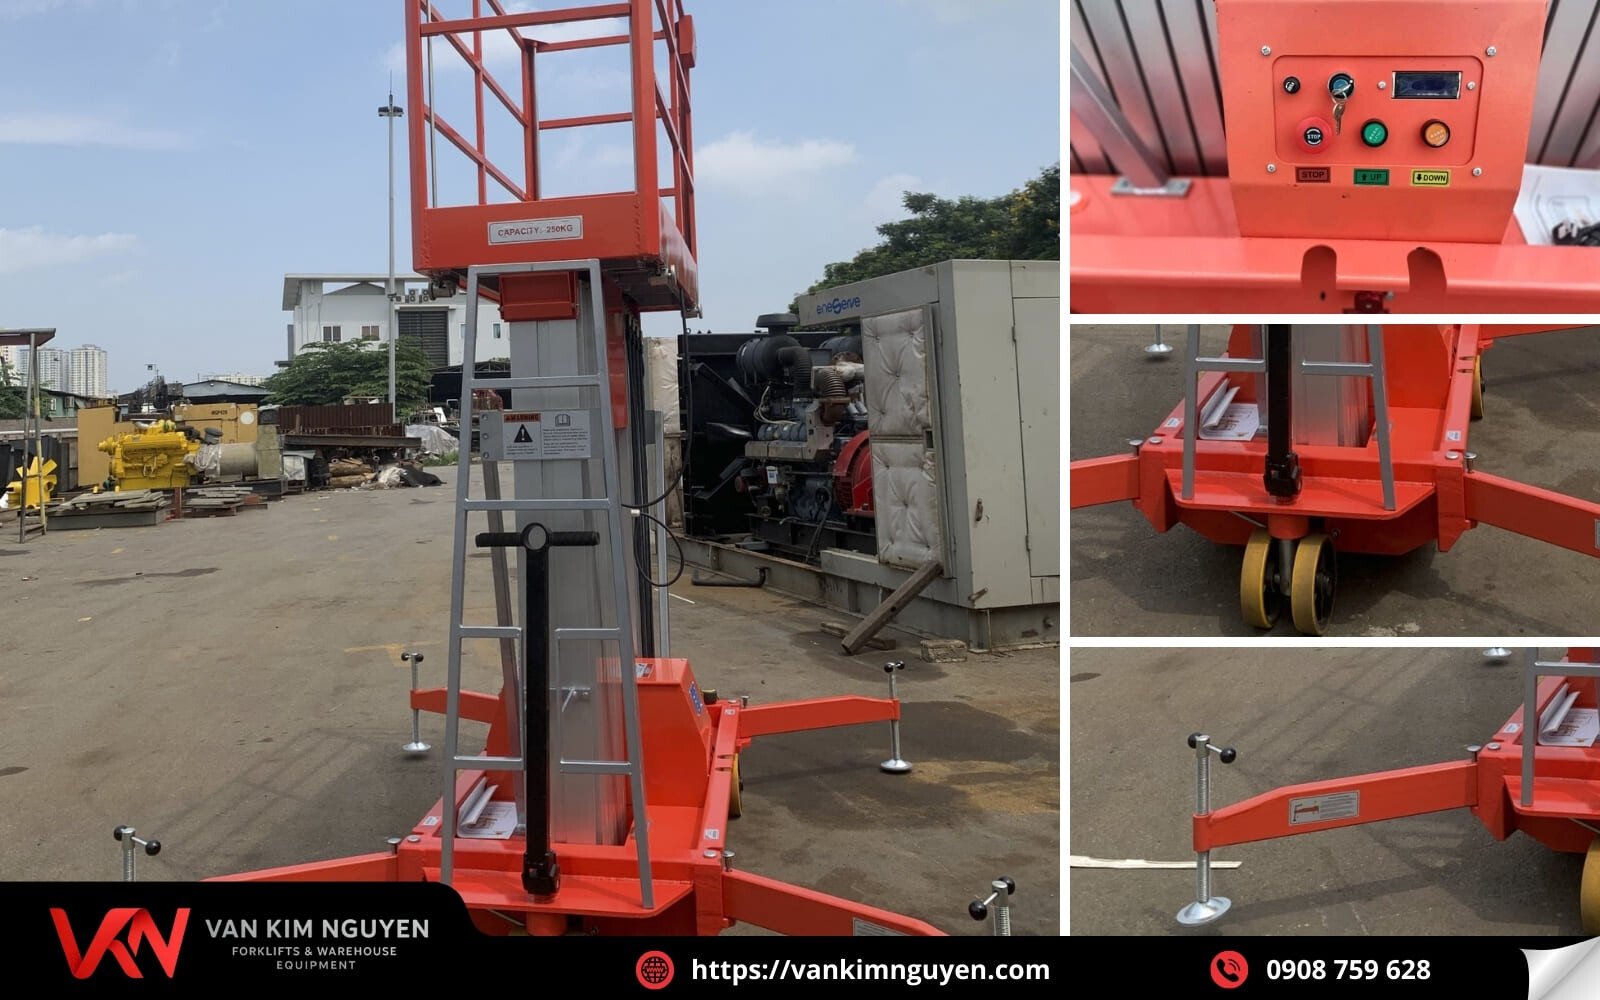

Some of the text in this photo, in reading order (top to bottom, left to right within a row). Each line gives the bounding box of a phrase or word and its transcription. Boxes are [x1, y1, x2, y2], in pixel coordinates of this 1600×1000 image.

[1301, 170, 1325, 179] STOP
[1369, 173, 1382, 182] UP
[1423, 174, 1446, 182] DOWN
[546, 224, 573, 233] 250KG
